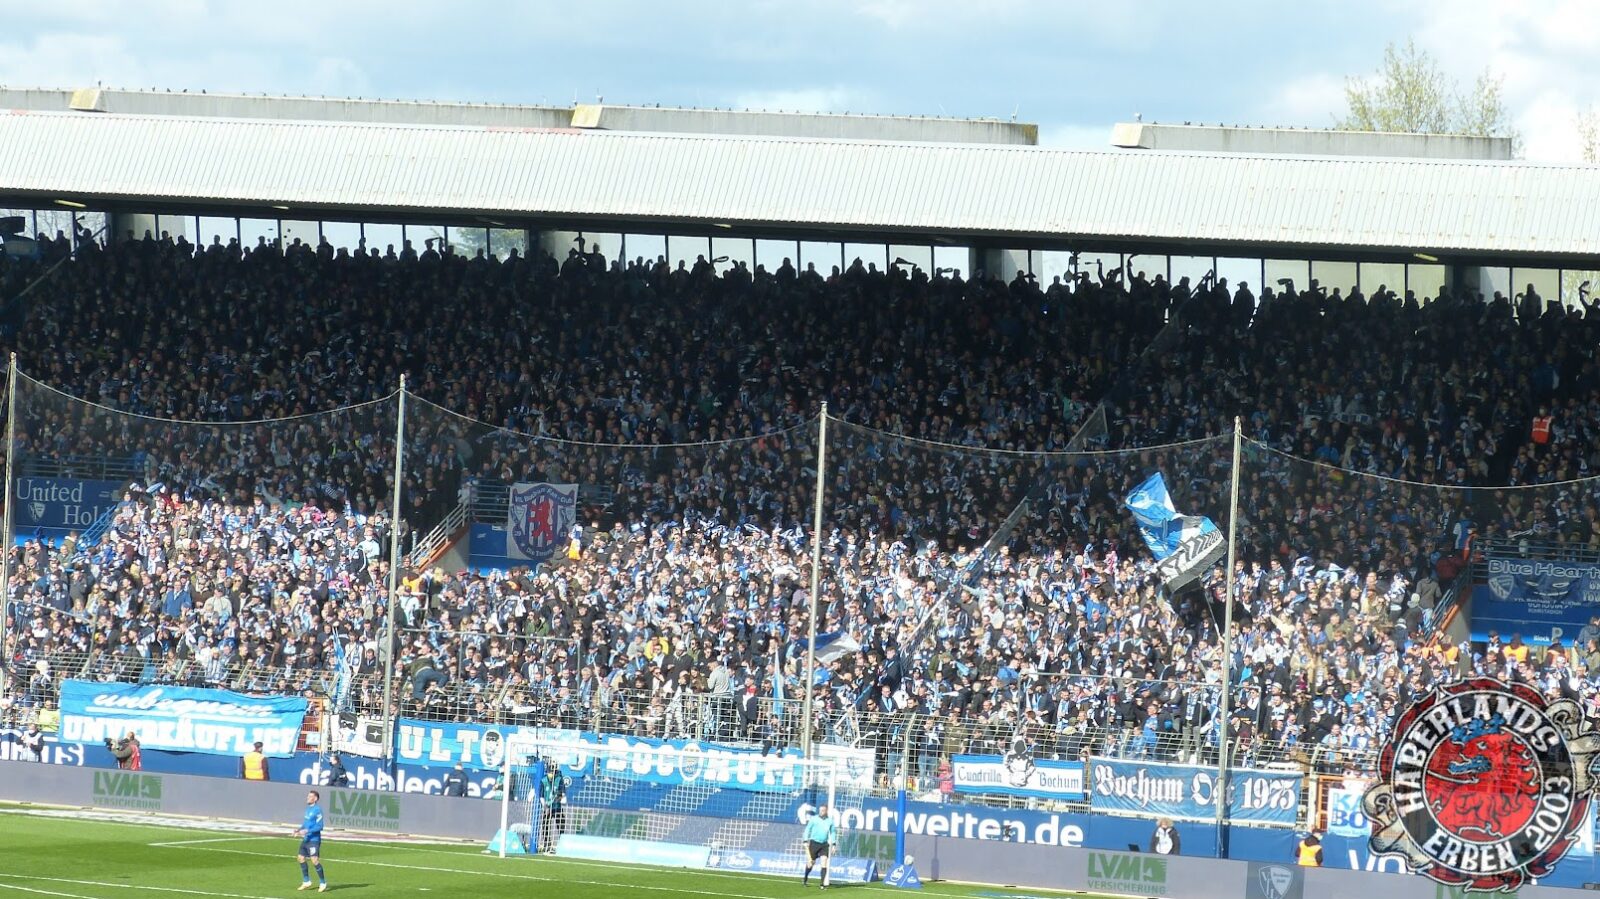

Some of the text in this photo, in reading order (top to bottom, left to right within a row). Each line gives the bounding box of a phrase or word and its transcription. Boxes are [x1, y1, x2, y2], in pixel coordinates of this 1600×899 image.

[16, 478, 83, 502] United
[1488, 560, 1533, 575] Blue
[1551, 626, 1564, 641] P
[957, 765, 1079, 790] Cuadrilla Bochum
[1094, 764, 1184, 807] Bochum
[1241, 776, 1295, 810] 1975
[93, 797, 160, 811] VERSICHERUNG
[330, 816, 400, 830] VERSICHERUNG
[1087, 852, 1142, 880] LVM
[1087, 880, 1166, 895] VERSICHERUNG
